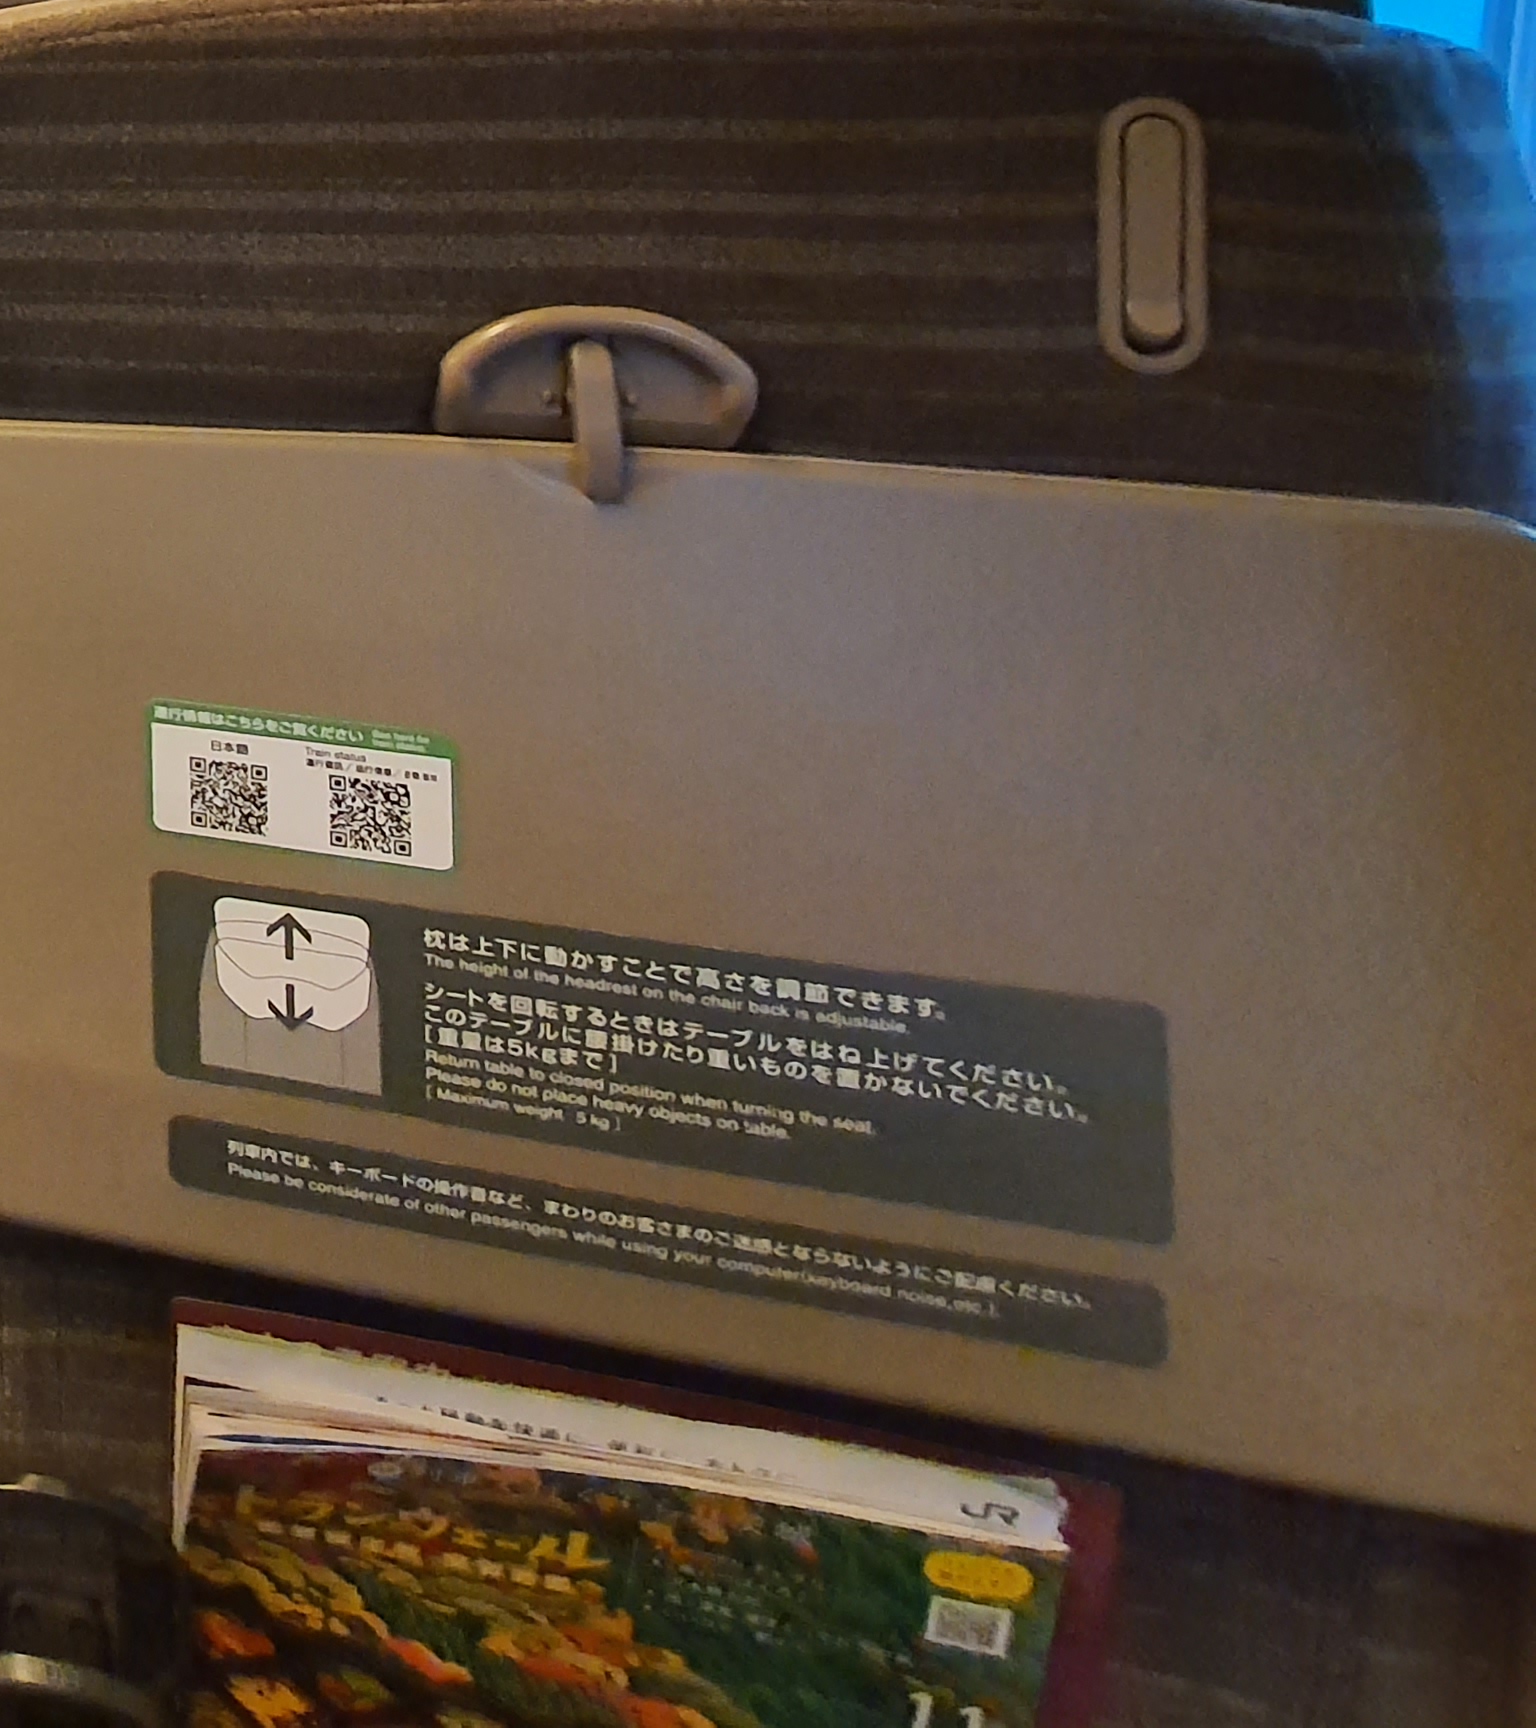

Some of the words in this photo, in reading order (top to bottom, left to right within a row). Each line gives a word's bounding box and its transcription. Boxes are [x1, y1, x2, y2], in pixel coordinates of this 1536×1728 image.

[424, 928, 946, 1021] 枕は上下に動かすことで高さを調節できます。
[427, 953, 453, 969] The
[459, 956, 507, 980] height
[513, 965, 529, 979] of
[534, 968, 558, 984] the
[565, 972, 637, 996] headrest
[642, 986, 662, 1000] on
[669, 988, 694, 1004] the
[424, 982, 1069, 1095] シートを回転するときはテーブルをはね上げてください。
[425, 1049, 479, 1070] Return
[485, 1059, 524, 1078] table
[529, 1067, 544, 1080] to
[549, 1069, 604, 1090] closed
[609, 1079, 675, 1104] position
[680, 1094, 728, 1110] when
[731, 1101, 795, 1124] turning
[425, 1066, 480, 1089] Please
[486, 1076, 506, 1093] do
[511, 1081, 537, 1098] not
[543, 1086, 586, 1108] place
[592, 1094, 643, 1117] heavy
[648, 1104, 712, 1128] objects
[716, 1114, 739, 1130] on
[229, 1161, 278, 1184] Please
[284, 1171, 303, 1189] be
[309, 1177, 400, 1207] considerate
[404, 1193, 419, 1210] of
[424, 1197, 465, 1219] other
[470, 1208, 567, 1242] passengers
[573, 1225, 615, 1248] while
[622, 1235, 667, 1260] using
